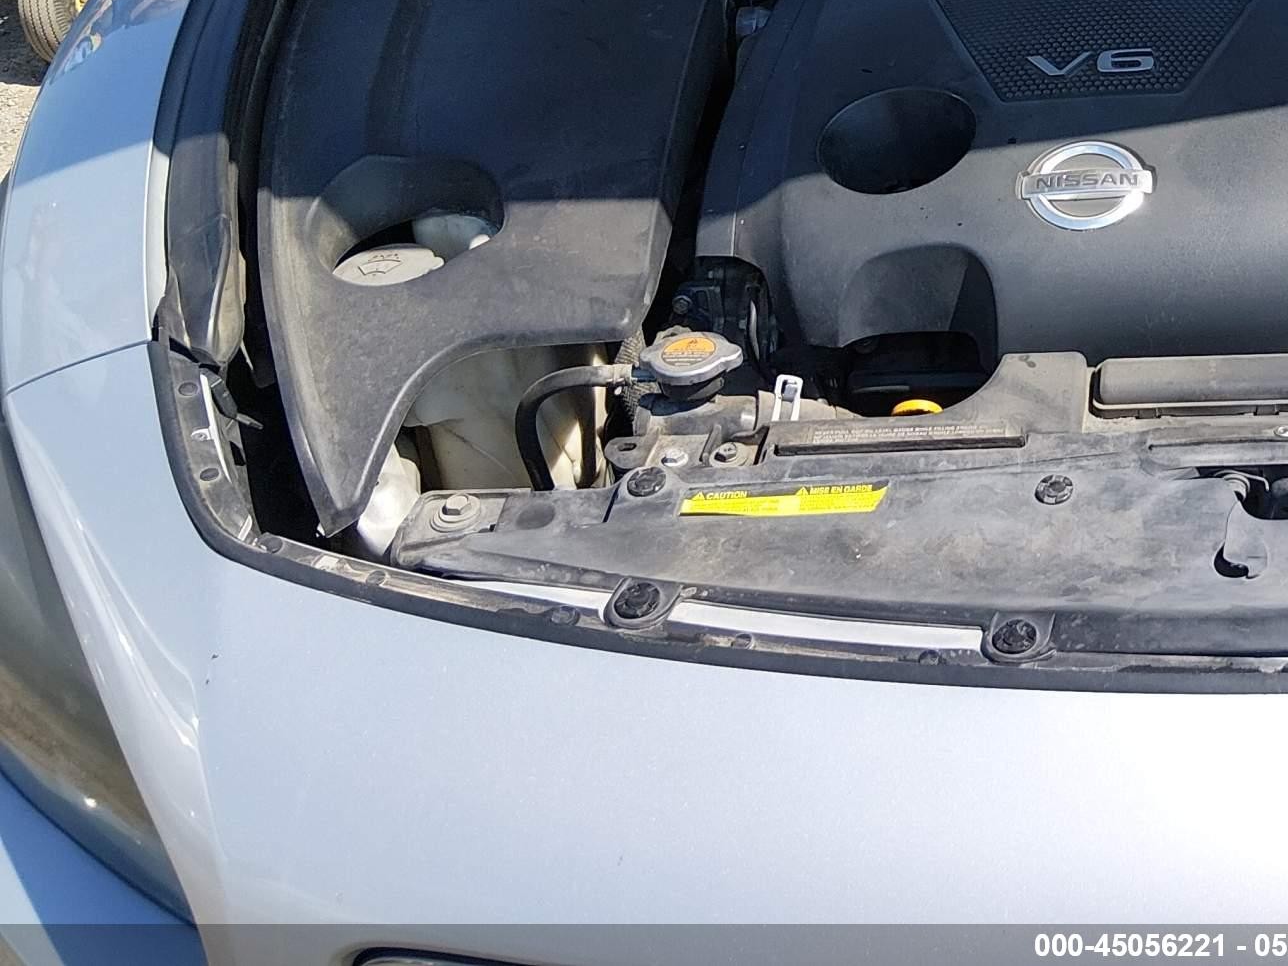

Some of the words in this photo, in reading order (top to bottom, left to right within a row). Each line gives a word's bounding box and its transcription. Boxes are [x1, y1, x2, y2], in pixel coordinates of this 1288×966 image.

[1026, 48, 1155, 76] V6
[1036, 173, 1139, 189] NISSAN
[705, 490, 748, 500] CAUTION
[809, 485, 829, 495] MISE
[830, 485, 843, 494] EN
[844, 484, 873, 493] GARDE
